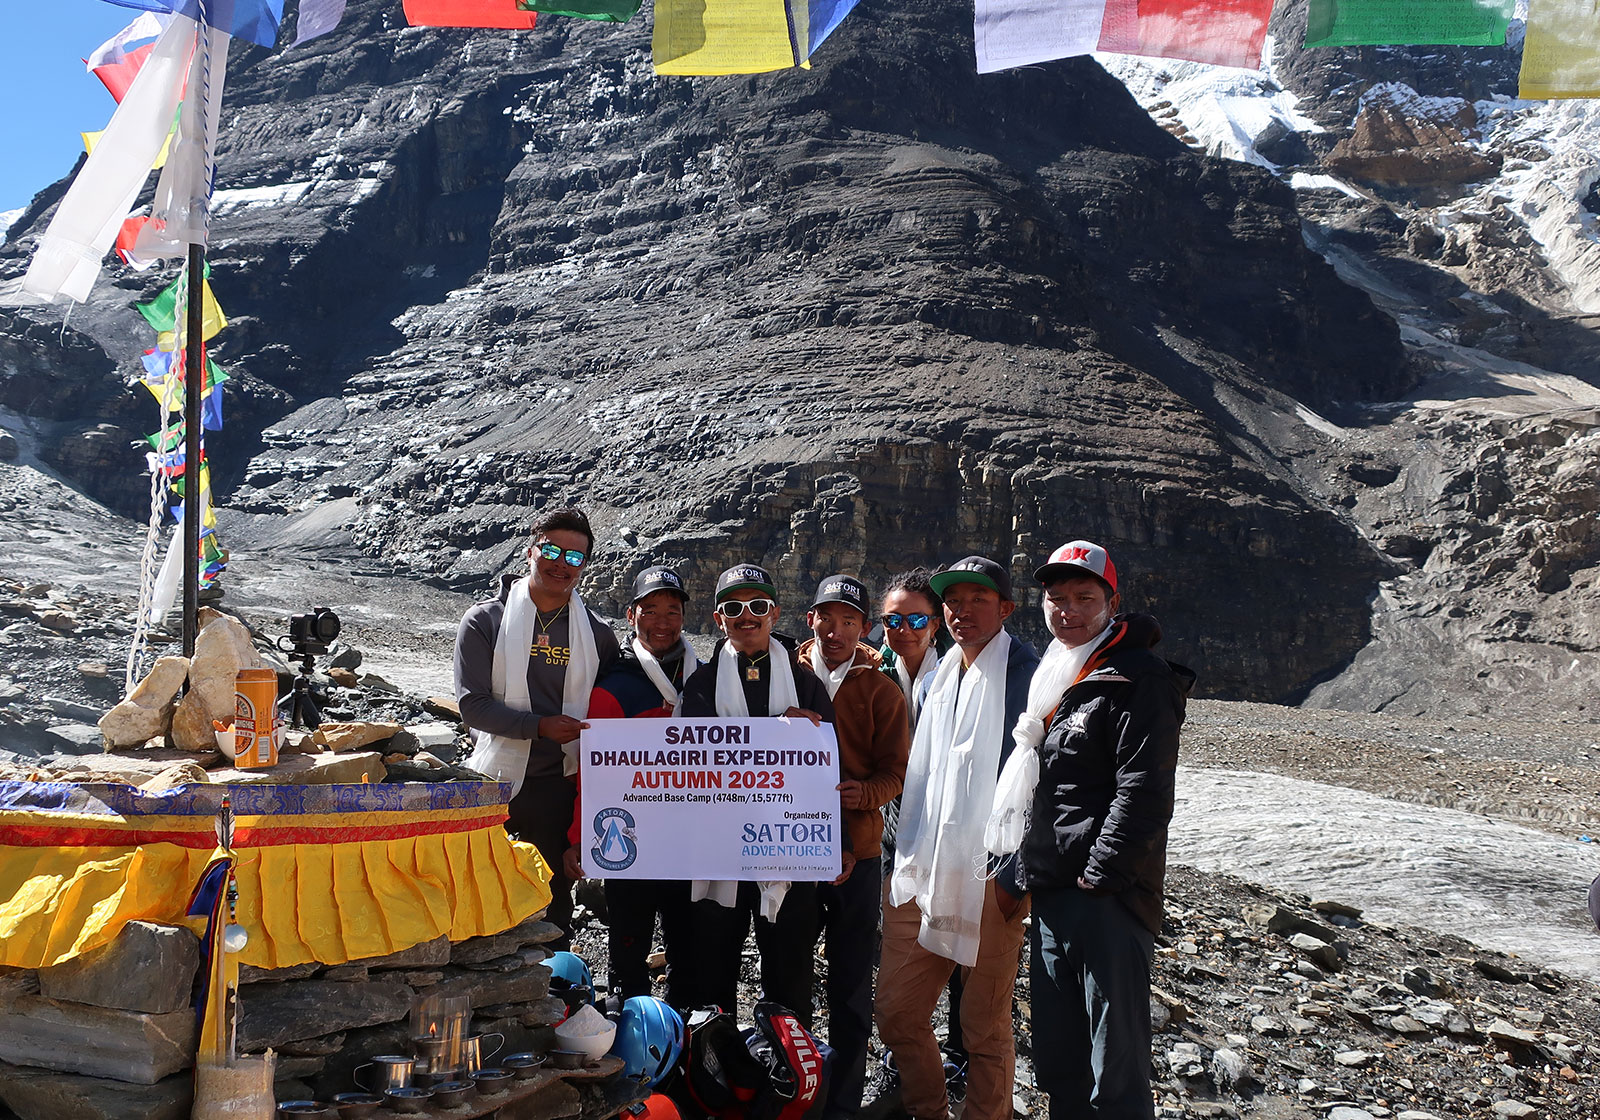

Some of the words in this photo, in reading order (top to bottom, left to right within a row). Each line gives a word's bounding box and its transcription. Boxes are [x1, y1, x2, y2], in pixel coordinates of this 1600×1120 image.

[645, 571, 678, 583] SATORI
[727, 569, 763, 579] SATORI
[825, 582, 860, 595] SATORI
[665, 726, 750, 744] SATORI
[591, 750, 707, 766] DHAULAGIRI
[714, 750, 831, 766] EXPEDITION
[632, 771, 722, 789] AUTUMN
[728, 771, 785, 789] 2023
[623, 793, 662, 802] Advanced
[665, 793, 685, 802] Base
[687, 793, 711, 804] Camp
[599, 810, 627, 820] SATORI
[784, 811, 820, 820] Organized
[821, 811, 832, 820] By:
[741, 823, 832, 843] SATORI
[741, 845, 832, 856] ADVENTURES
[784, 1018, 818, 1101] MILLET
